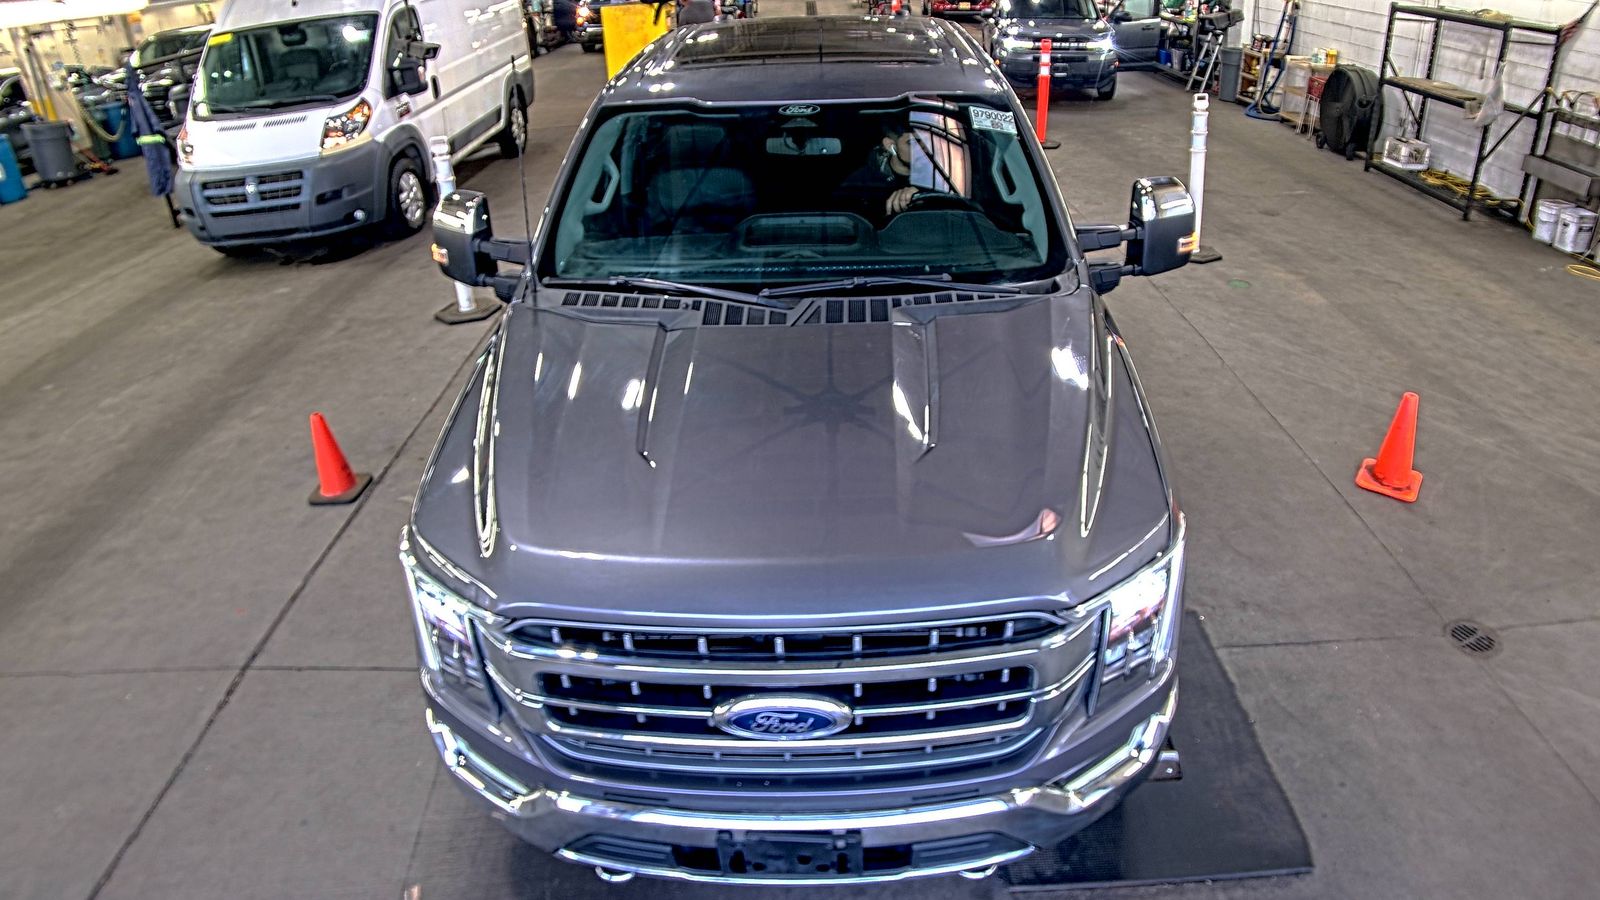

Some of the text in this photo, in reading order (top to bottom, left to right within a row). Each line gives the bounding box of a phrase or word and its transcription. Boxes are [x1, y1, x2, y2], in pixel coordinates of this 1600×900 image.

[786, 104, 814, 113] Ford
[972, 109, 1014, 123] 9790022
[750, 711, 815, 733] Ford
